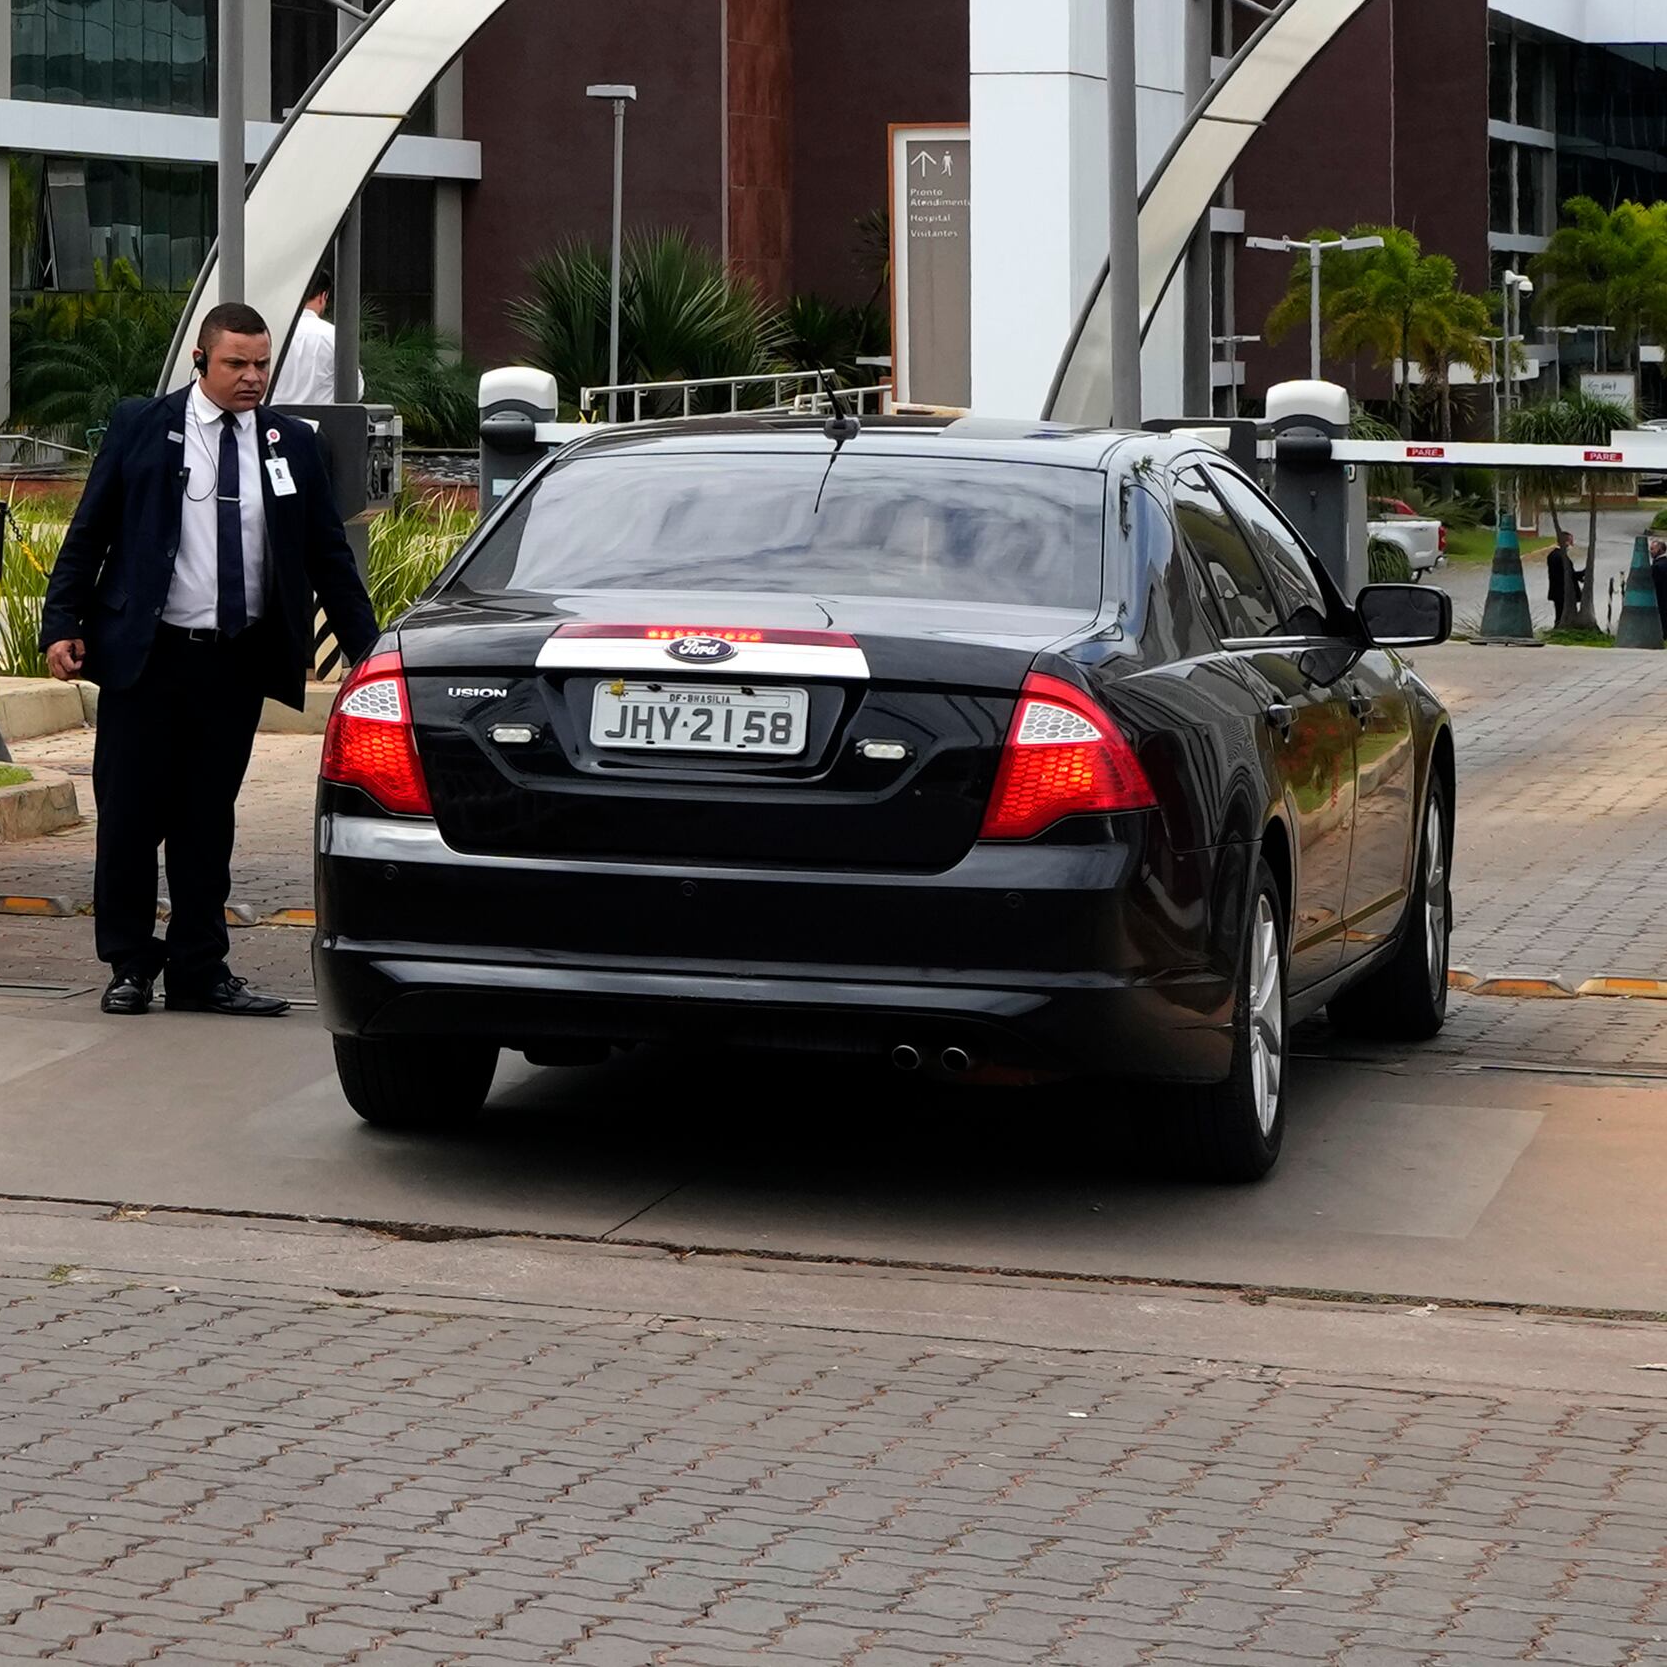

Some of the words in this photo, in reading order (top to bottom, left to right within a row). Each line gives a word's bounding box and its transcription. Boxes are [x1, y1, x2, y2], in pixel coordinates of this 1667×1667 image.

[910, 188, 943, 196] Pronto
[910, 214, 951, 223] Hospital
[910, 229, 958, 237] Visitantes
[1411, 447, 1438, 457] PARE
[1590, 452, 1617, 461] PARE
[678, 638, 721, 655] Ford
[448, 687, 507, 698] USION
